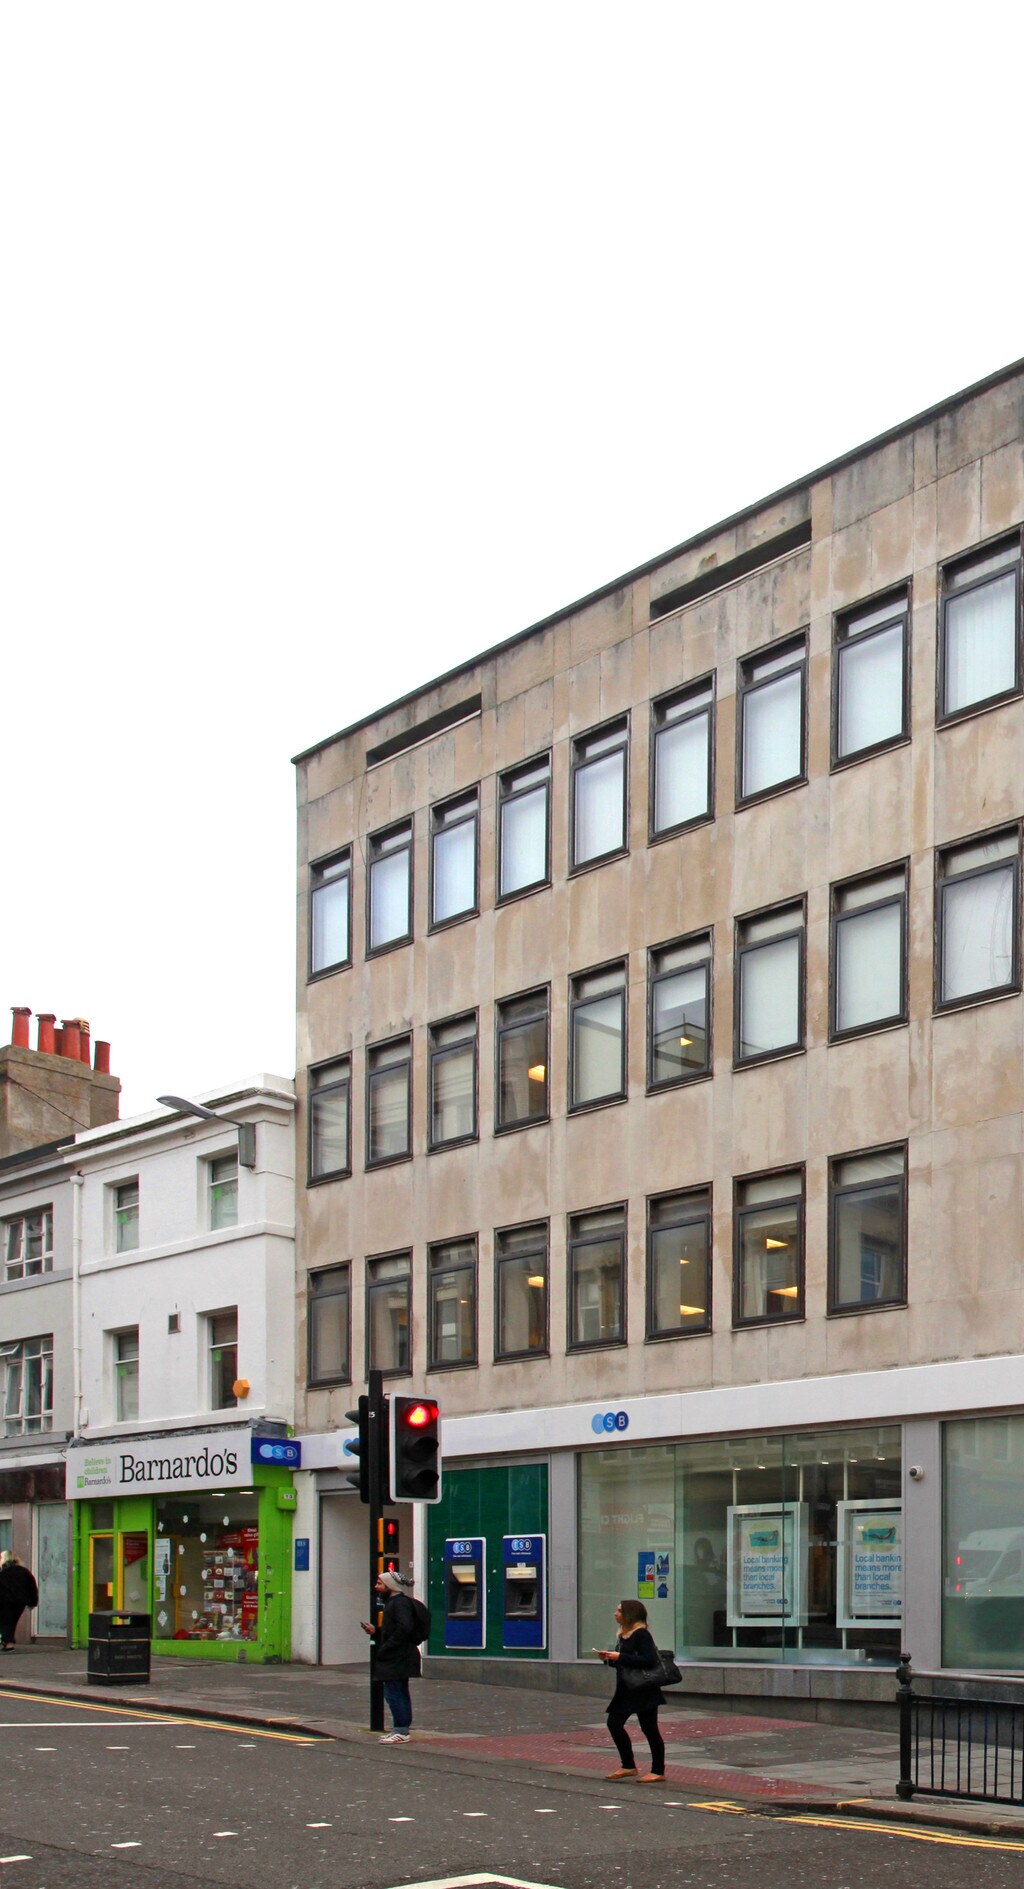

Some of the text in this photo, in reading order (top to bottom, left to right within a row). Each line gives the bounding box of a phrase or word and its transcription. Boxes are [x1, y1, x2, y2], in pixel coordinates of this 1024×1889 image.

[120, 1448, 238, 1483] Barnardo's
[84, 1476, 112, 1486] Barnardo's
[743, 1556, 761, 1564] Local
[855, 1553, 902, 1562] Local bankin
[855, 1564, 881, 1572] means
[743, 1573, 758, 1581] than
[854, 1572, 891, 1581] than local
[854, 1582, 892, 1590] branches.
